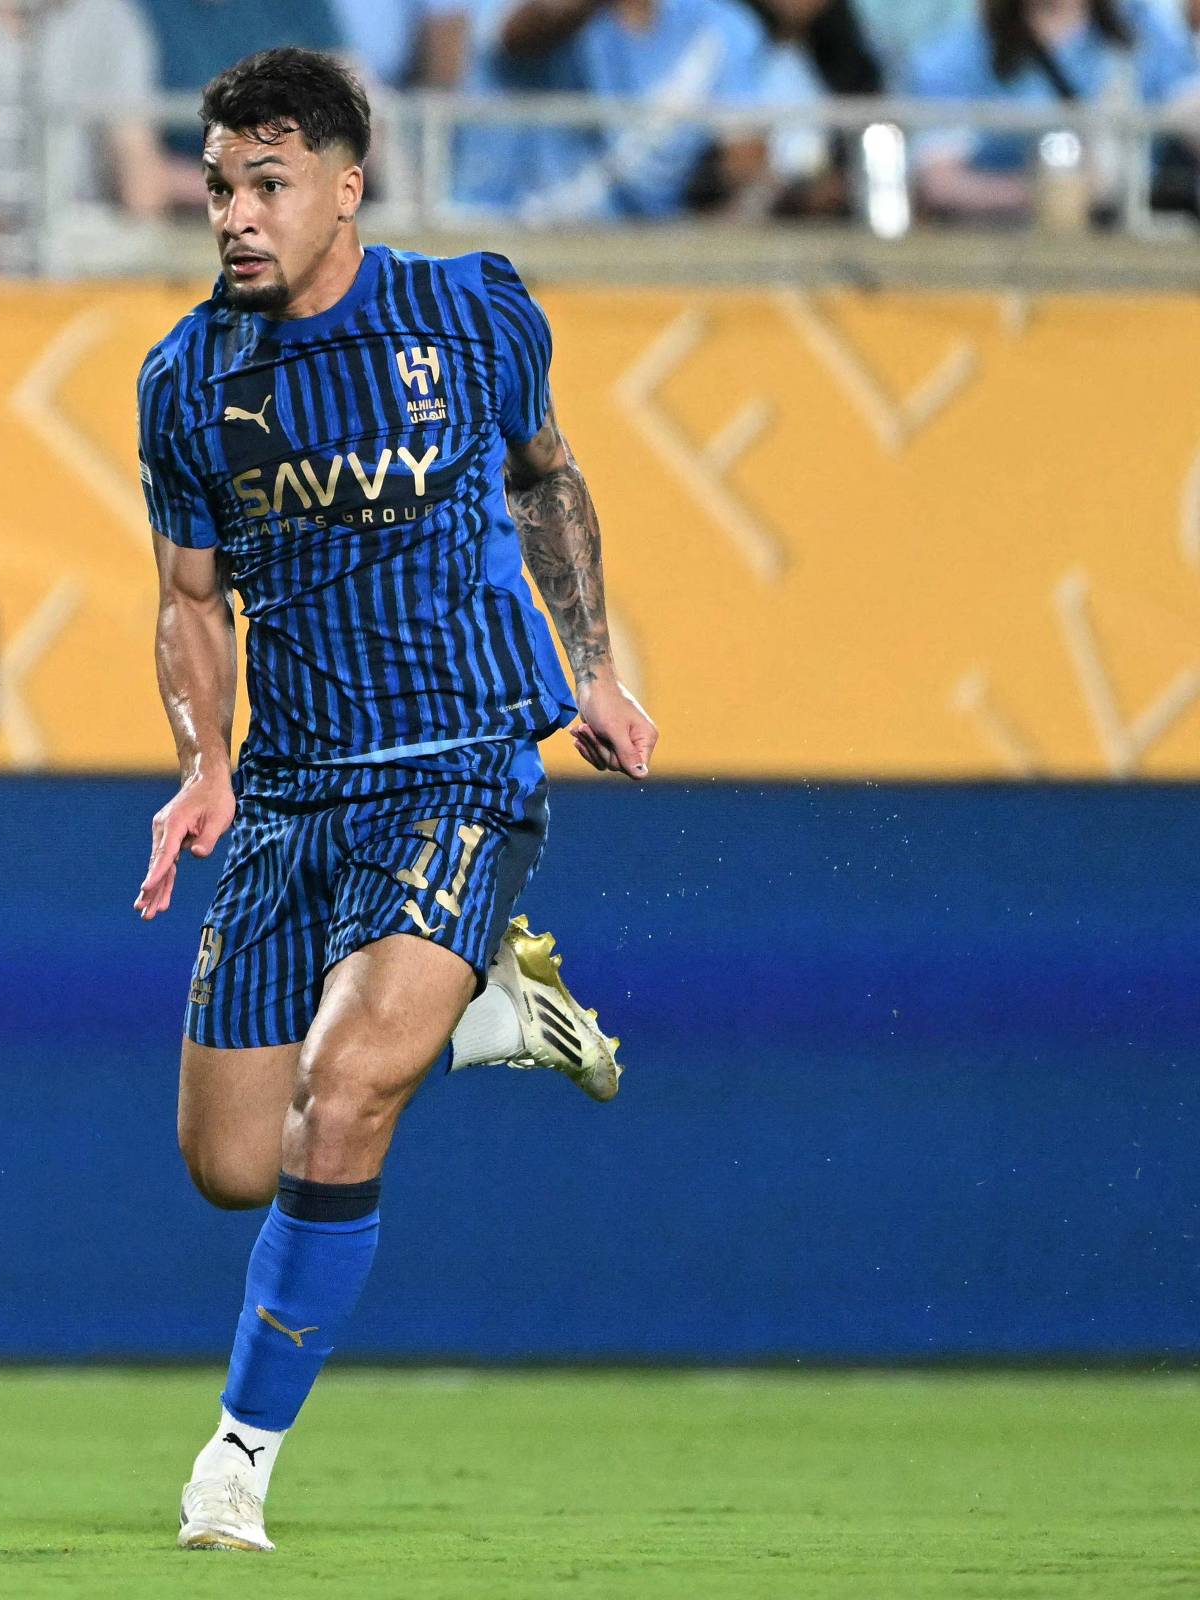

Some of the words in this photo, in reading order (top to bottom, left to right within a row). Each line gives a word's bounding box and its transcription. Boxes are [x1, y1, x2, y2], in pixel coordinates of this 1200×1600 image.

[407, 398, 446, 412] ALHILAL
[233, 445, 439, 517] SAVVY
[396, 818, 485, 918] 11
